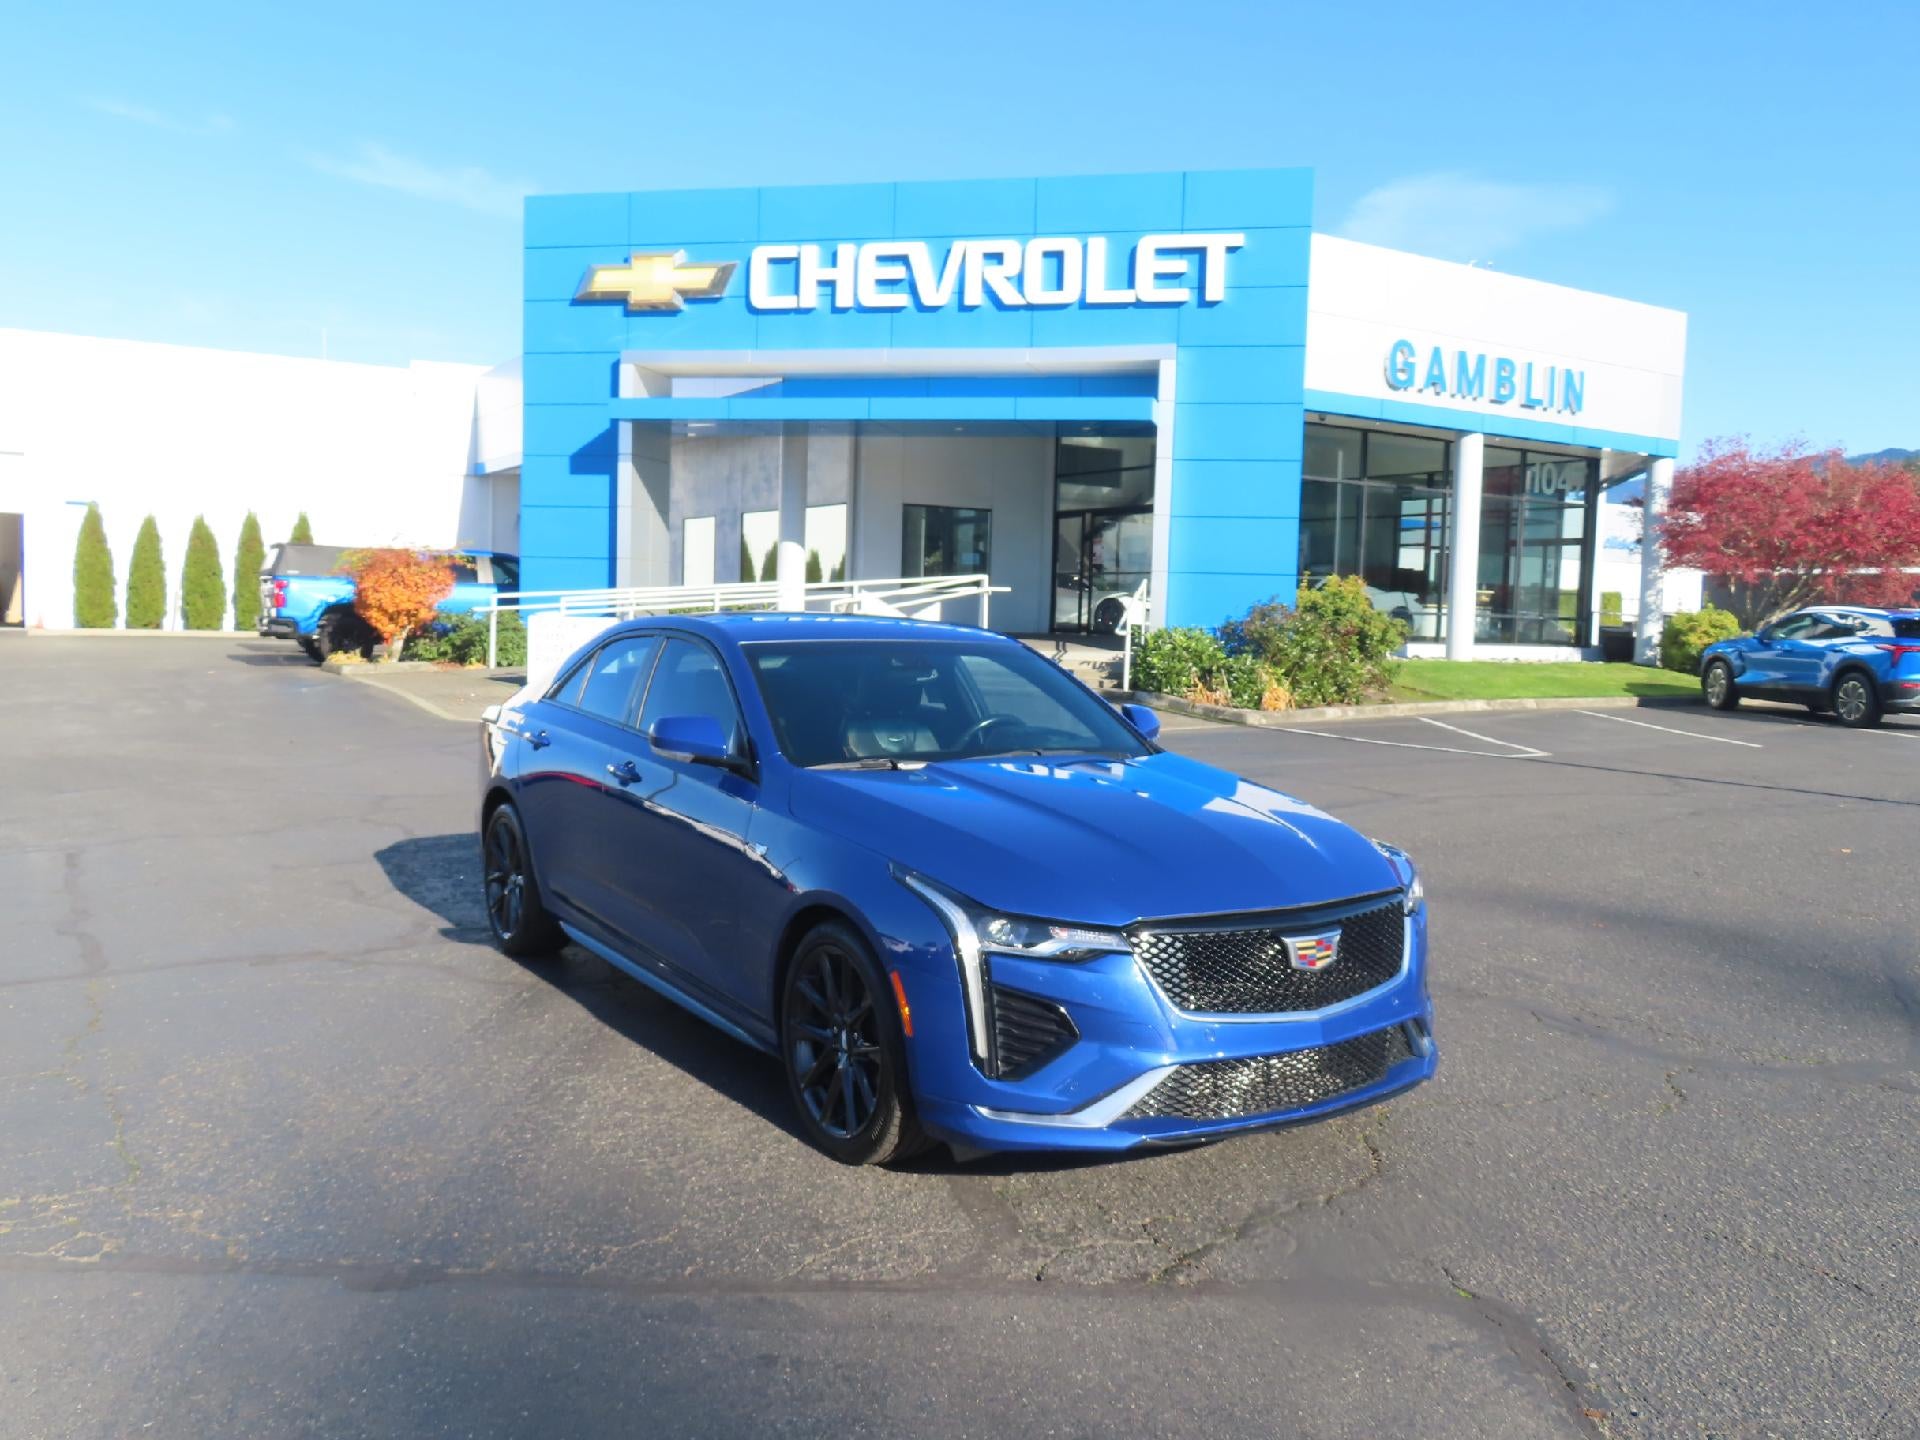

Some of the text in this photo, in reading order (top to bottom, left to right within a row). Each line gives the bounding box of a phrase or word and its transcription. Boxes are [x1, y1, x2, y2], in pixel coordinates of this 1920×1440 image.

[749, 233, 1245, 311] CHEVROLET
[1386, 339, 1585, 414] GAMBLIN
[1532, 462, 1584, 496] 104
